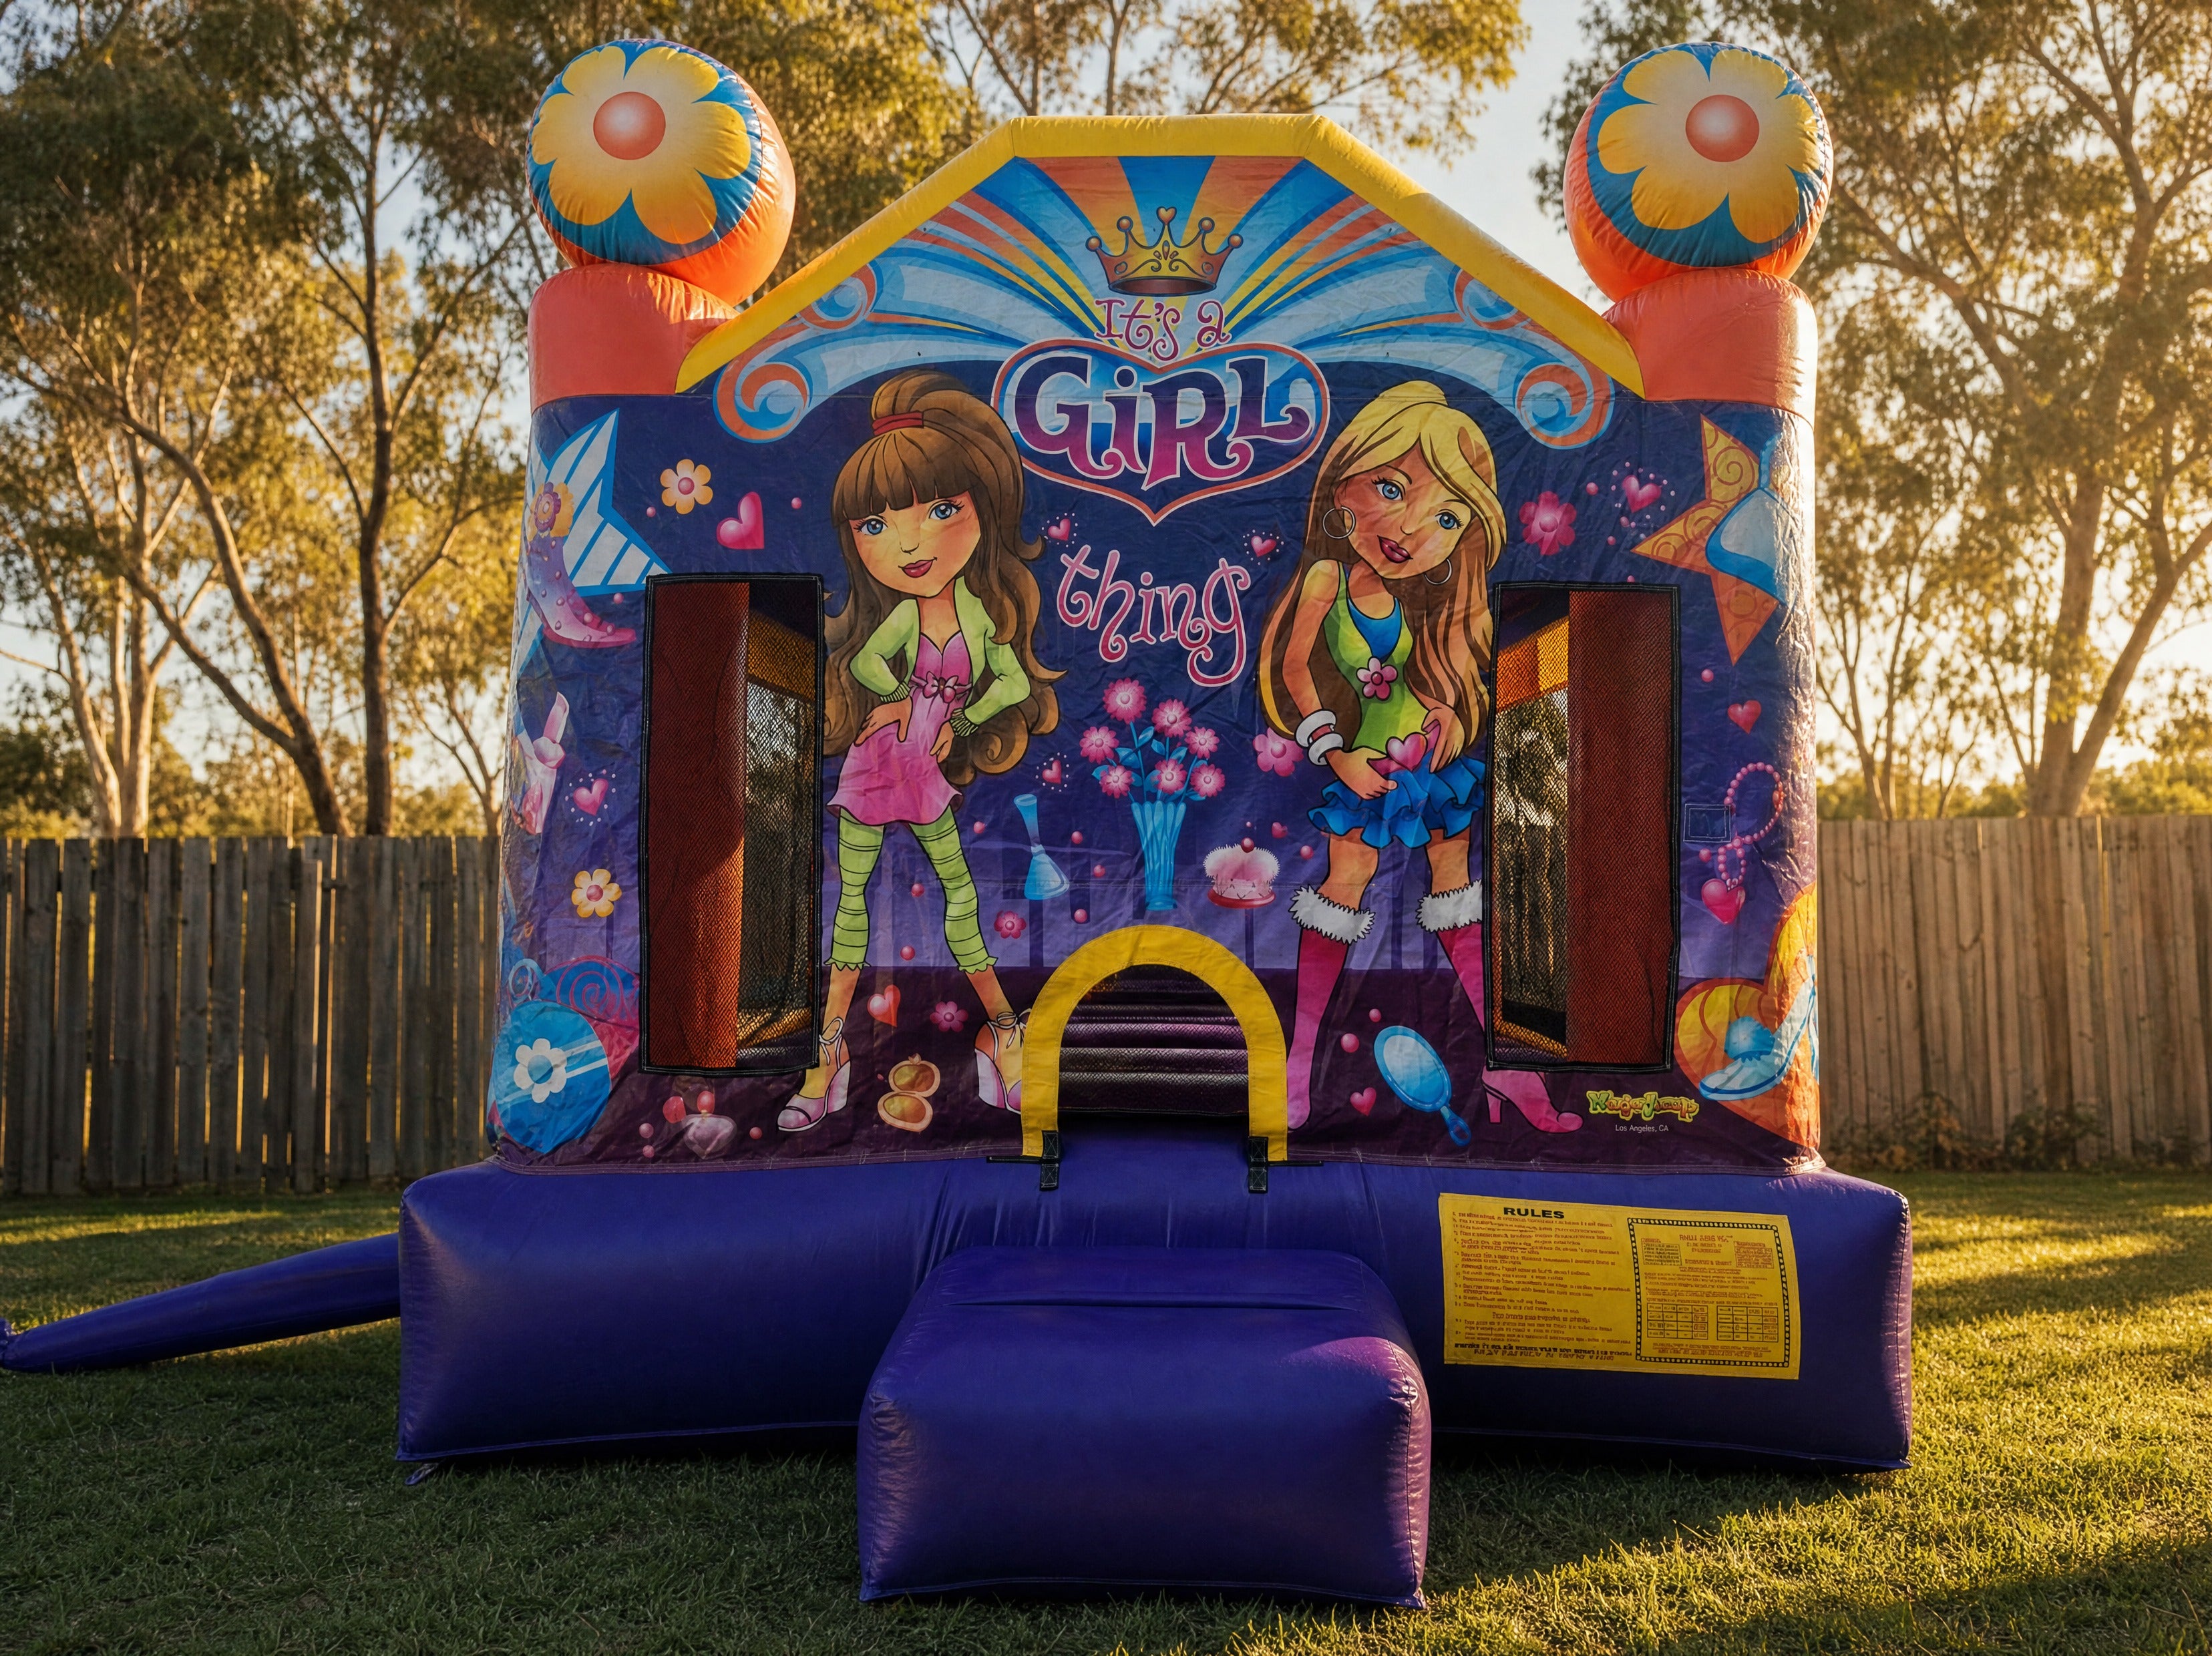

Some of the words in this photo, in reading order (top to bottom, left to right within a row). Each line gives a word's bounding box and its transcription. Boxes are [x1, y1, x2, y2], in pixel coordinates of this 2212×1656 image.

[1095, 298, 1181, 361] It's
[1196, 299, 1232, 349] a
[1055, 544, 1252, 688] thing
[1629, 1124, 1658, 1134] Angeles,
[1503, 1207, 1565, 1219] RULES
